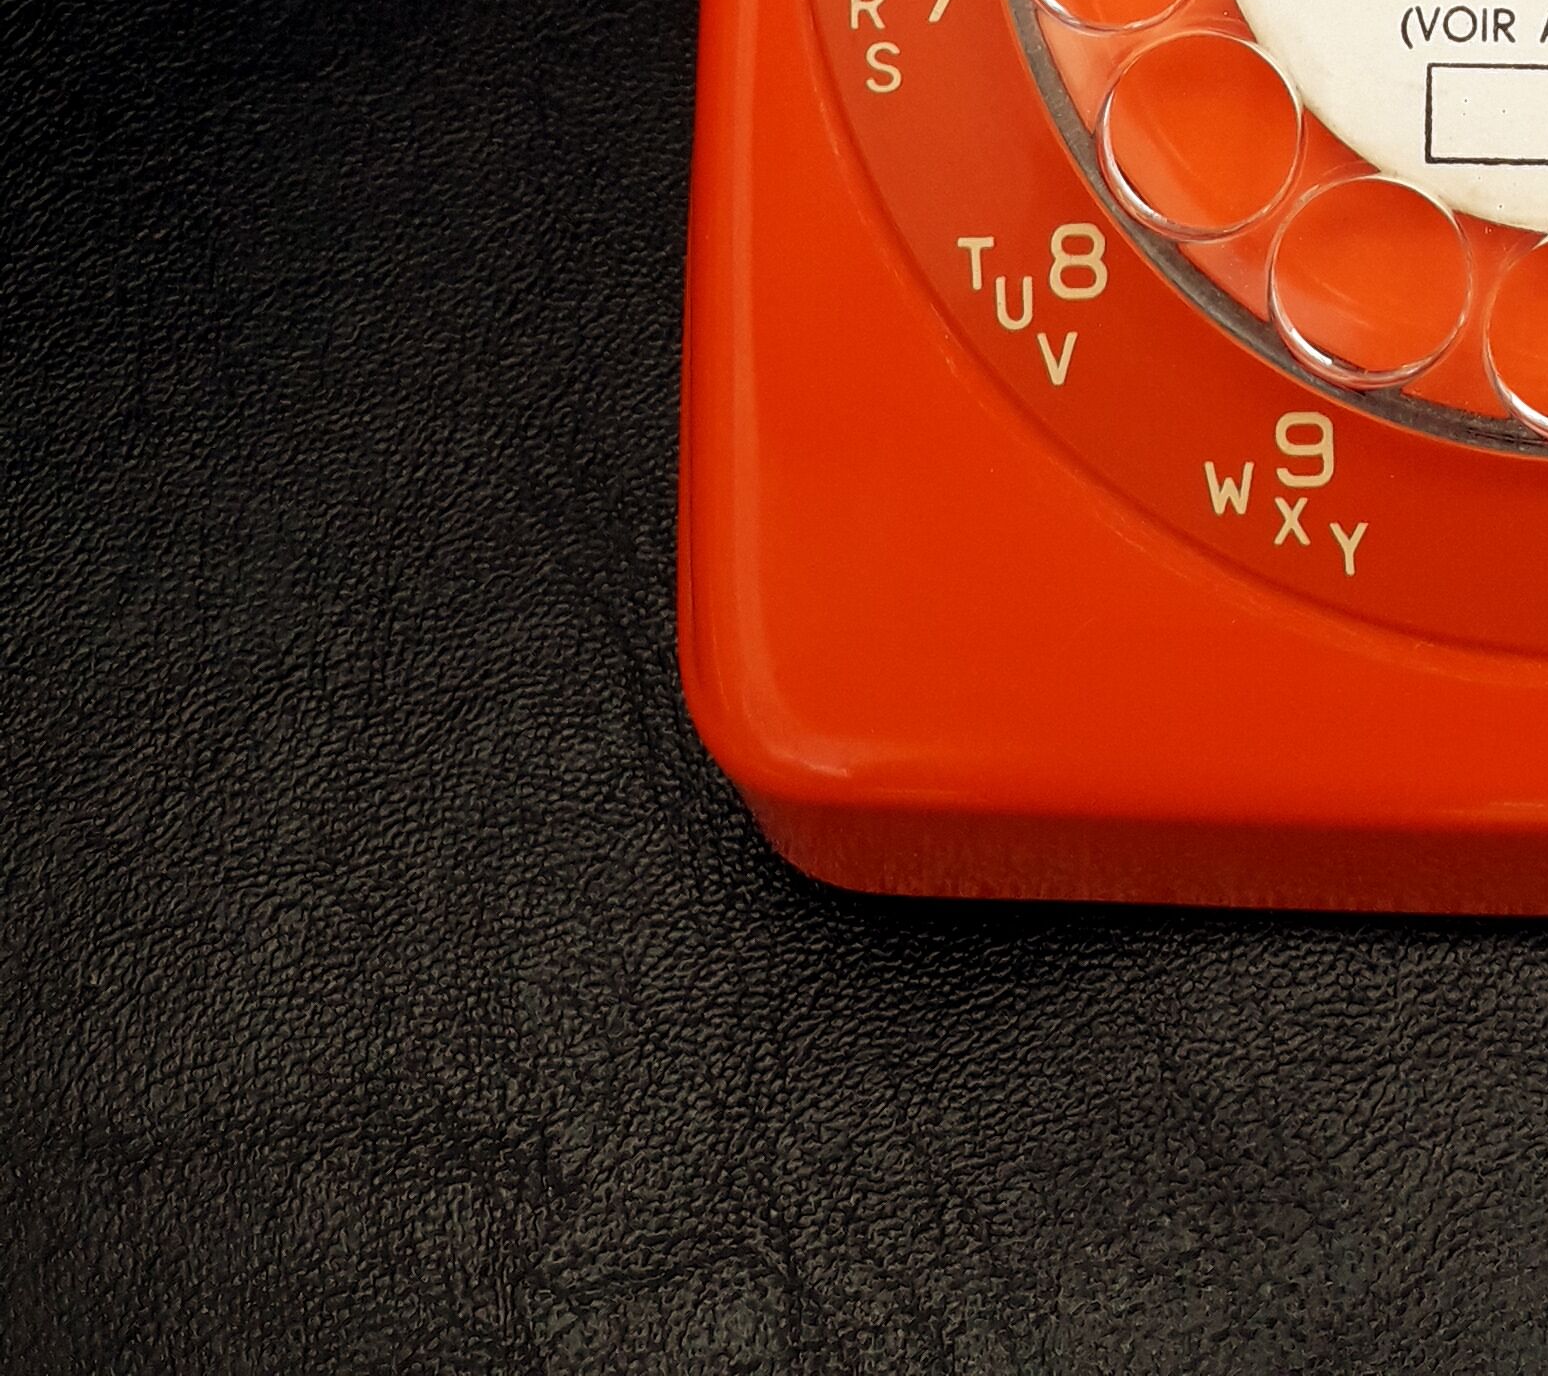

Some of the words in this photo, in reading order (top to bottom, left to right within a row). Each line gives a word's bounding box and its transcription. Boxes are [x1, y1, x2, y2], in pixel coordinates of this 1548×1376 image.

[1400, 5, 1517, 51] (VOIR
[1048, 223, 1108, 299] 8
[1274, 410, 1335, 488] 9
